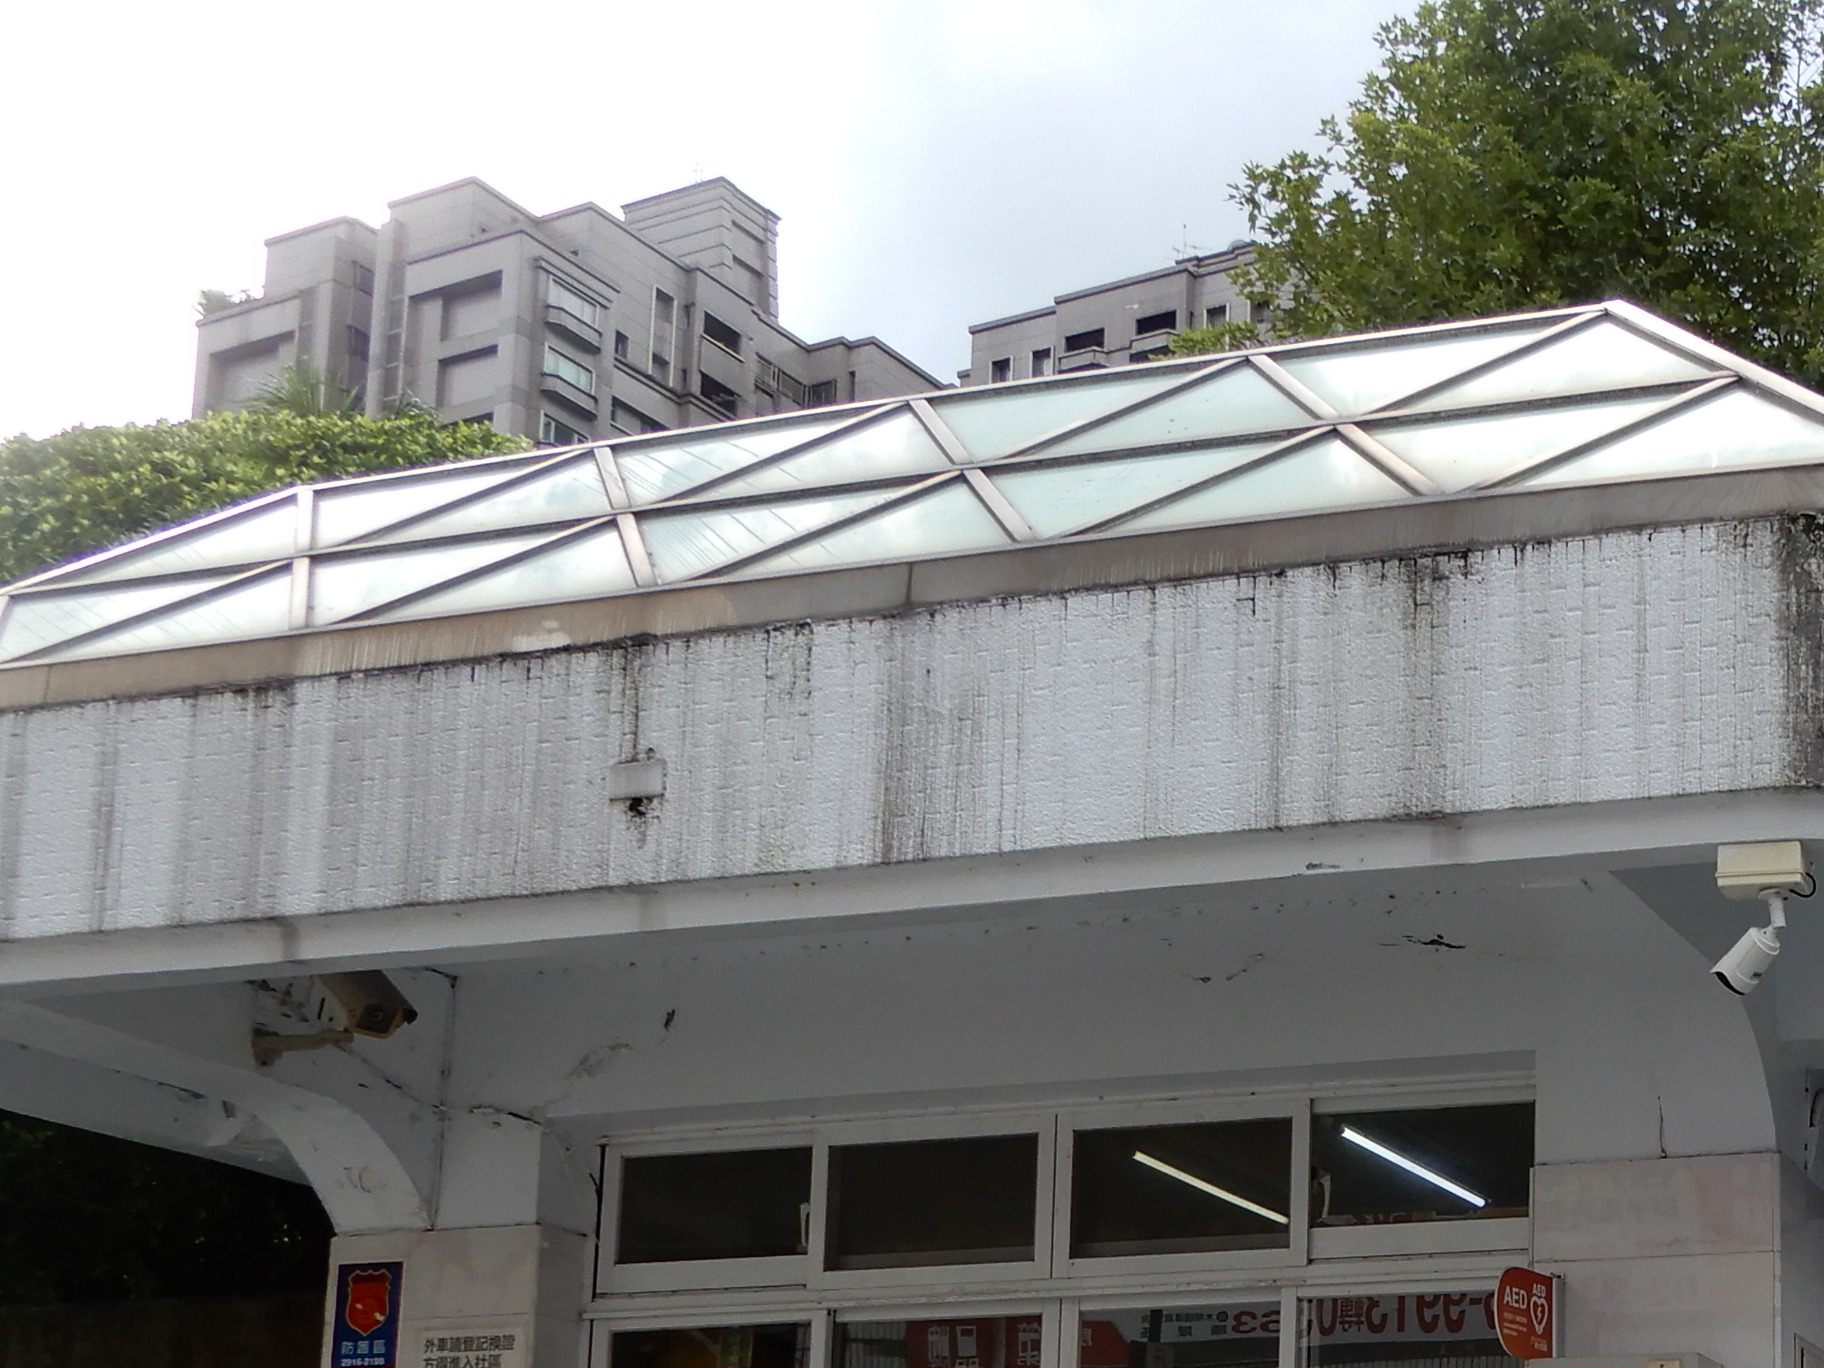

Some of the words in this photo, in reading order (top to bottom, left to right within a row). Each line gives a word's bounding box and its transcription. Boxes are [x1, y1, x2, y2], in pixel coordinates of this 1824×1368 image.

[1504, 1286, 1527, 1309] AED
[1532, 1283, 1546, 1297] AED
[423, 1335, 515, 1353] 外車請登記換證
